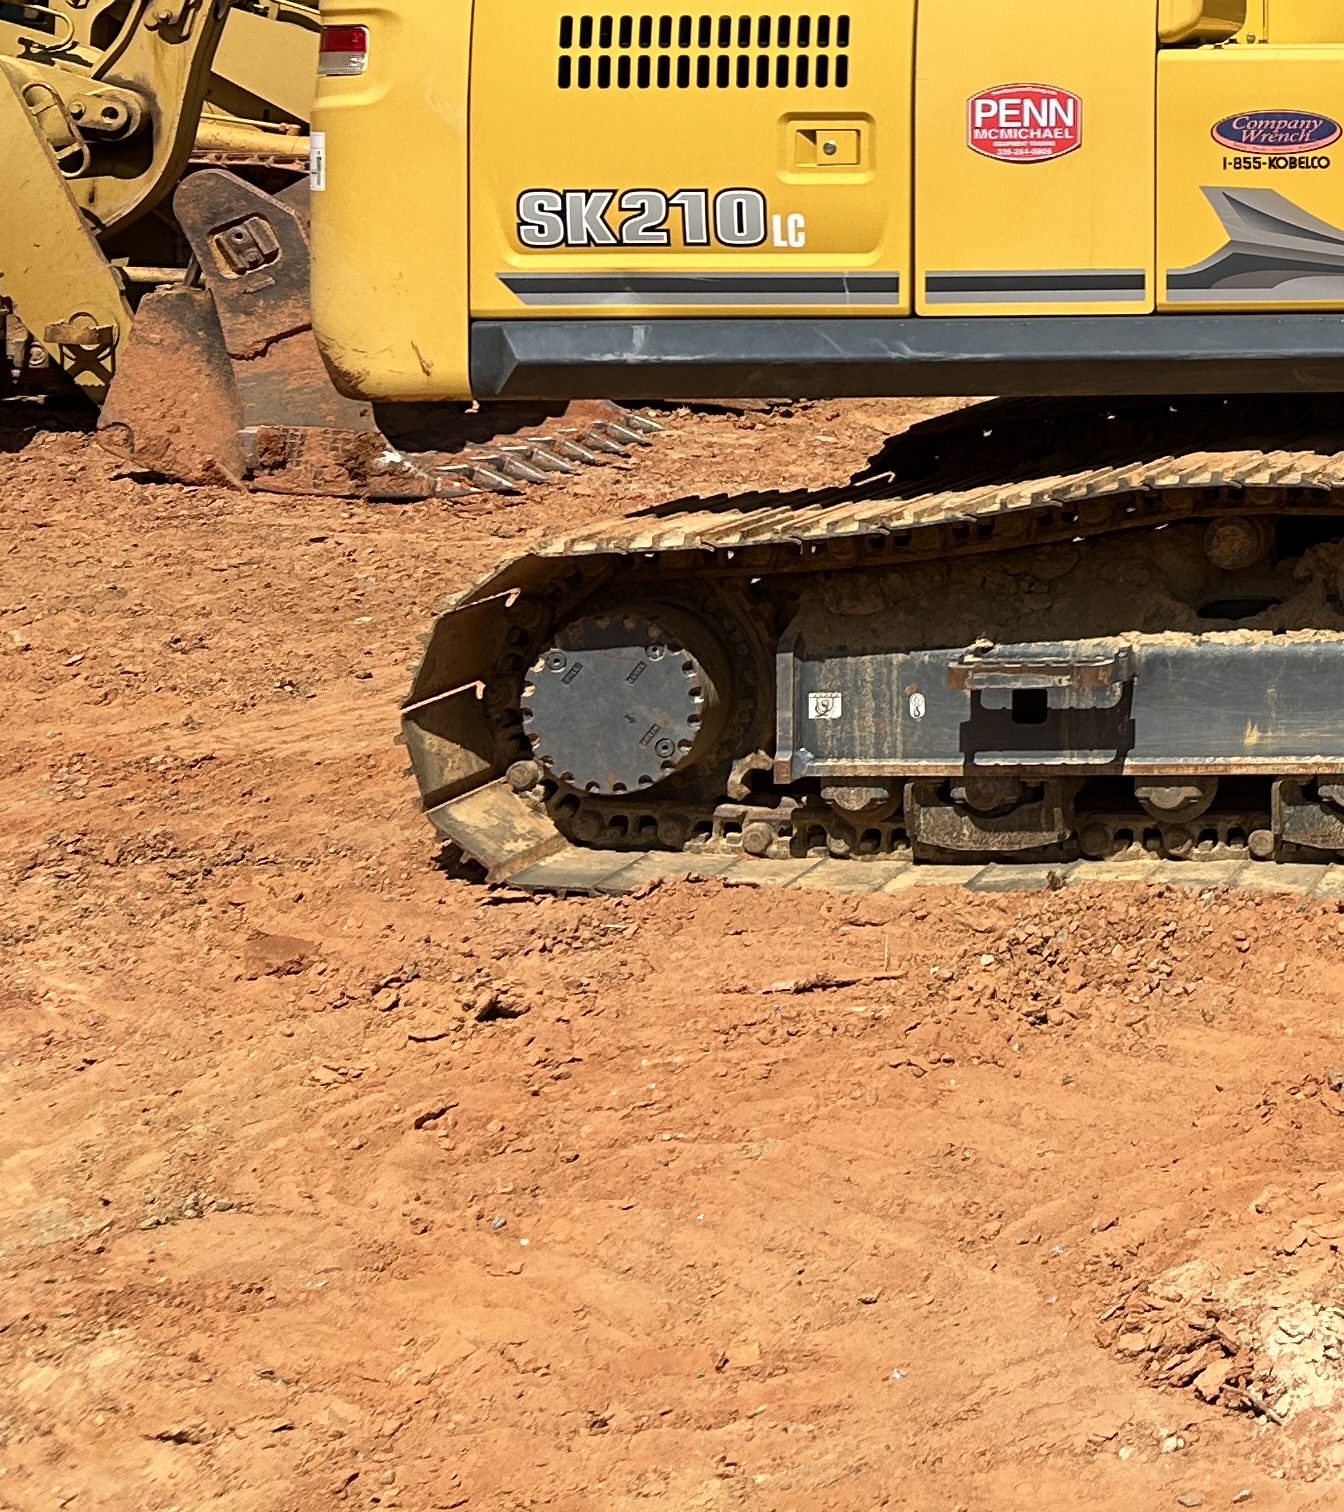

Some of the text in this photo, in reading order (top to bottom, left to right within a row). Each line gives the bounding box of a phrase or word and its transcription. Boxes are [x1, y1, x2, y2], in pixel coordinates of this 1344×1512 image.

[974, 98, 1075, 128] PENN
[1231, 115, 1324, 134] Company
[973, 128, 1076, 140] MCMICHAEL
[1242, 128, 1312, 143] Wrench
[1222, 155, 1331, 170] 1-855-KOBELCO
[516, 187, 806, 249] SK210 LC
